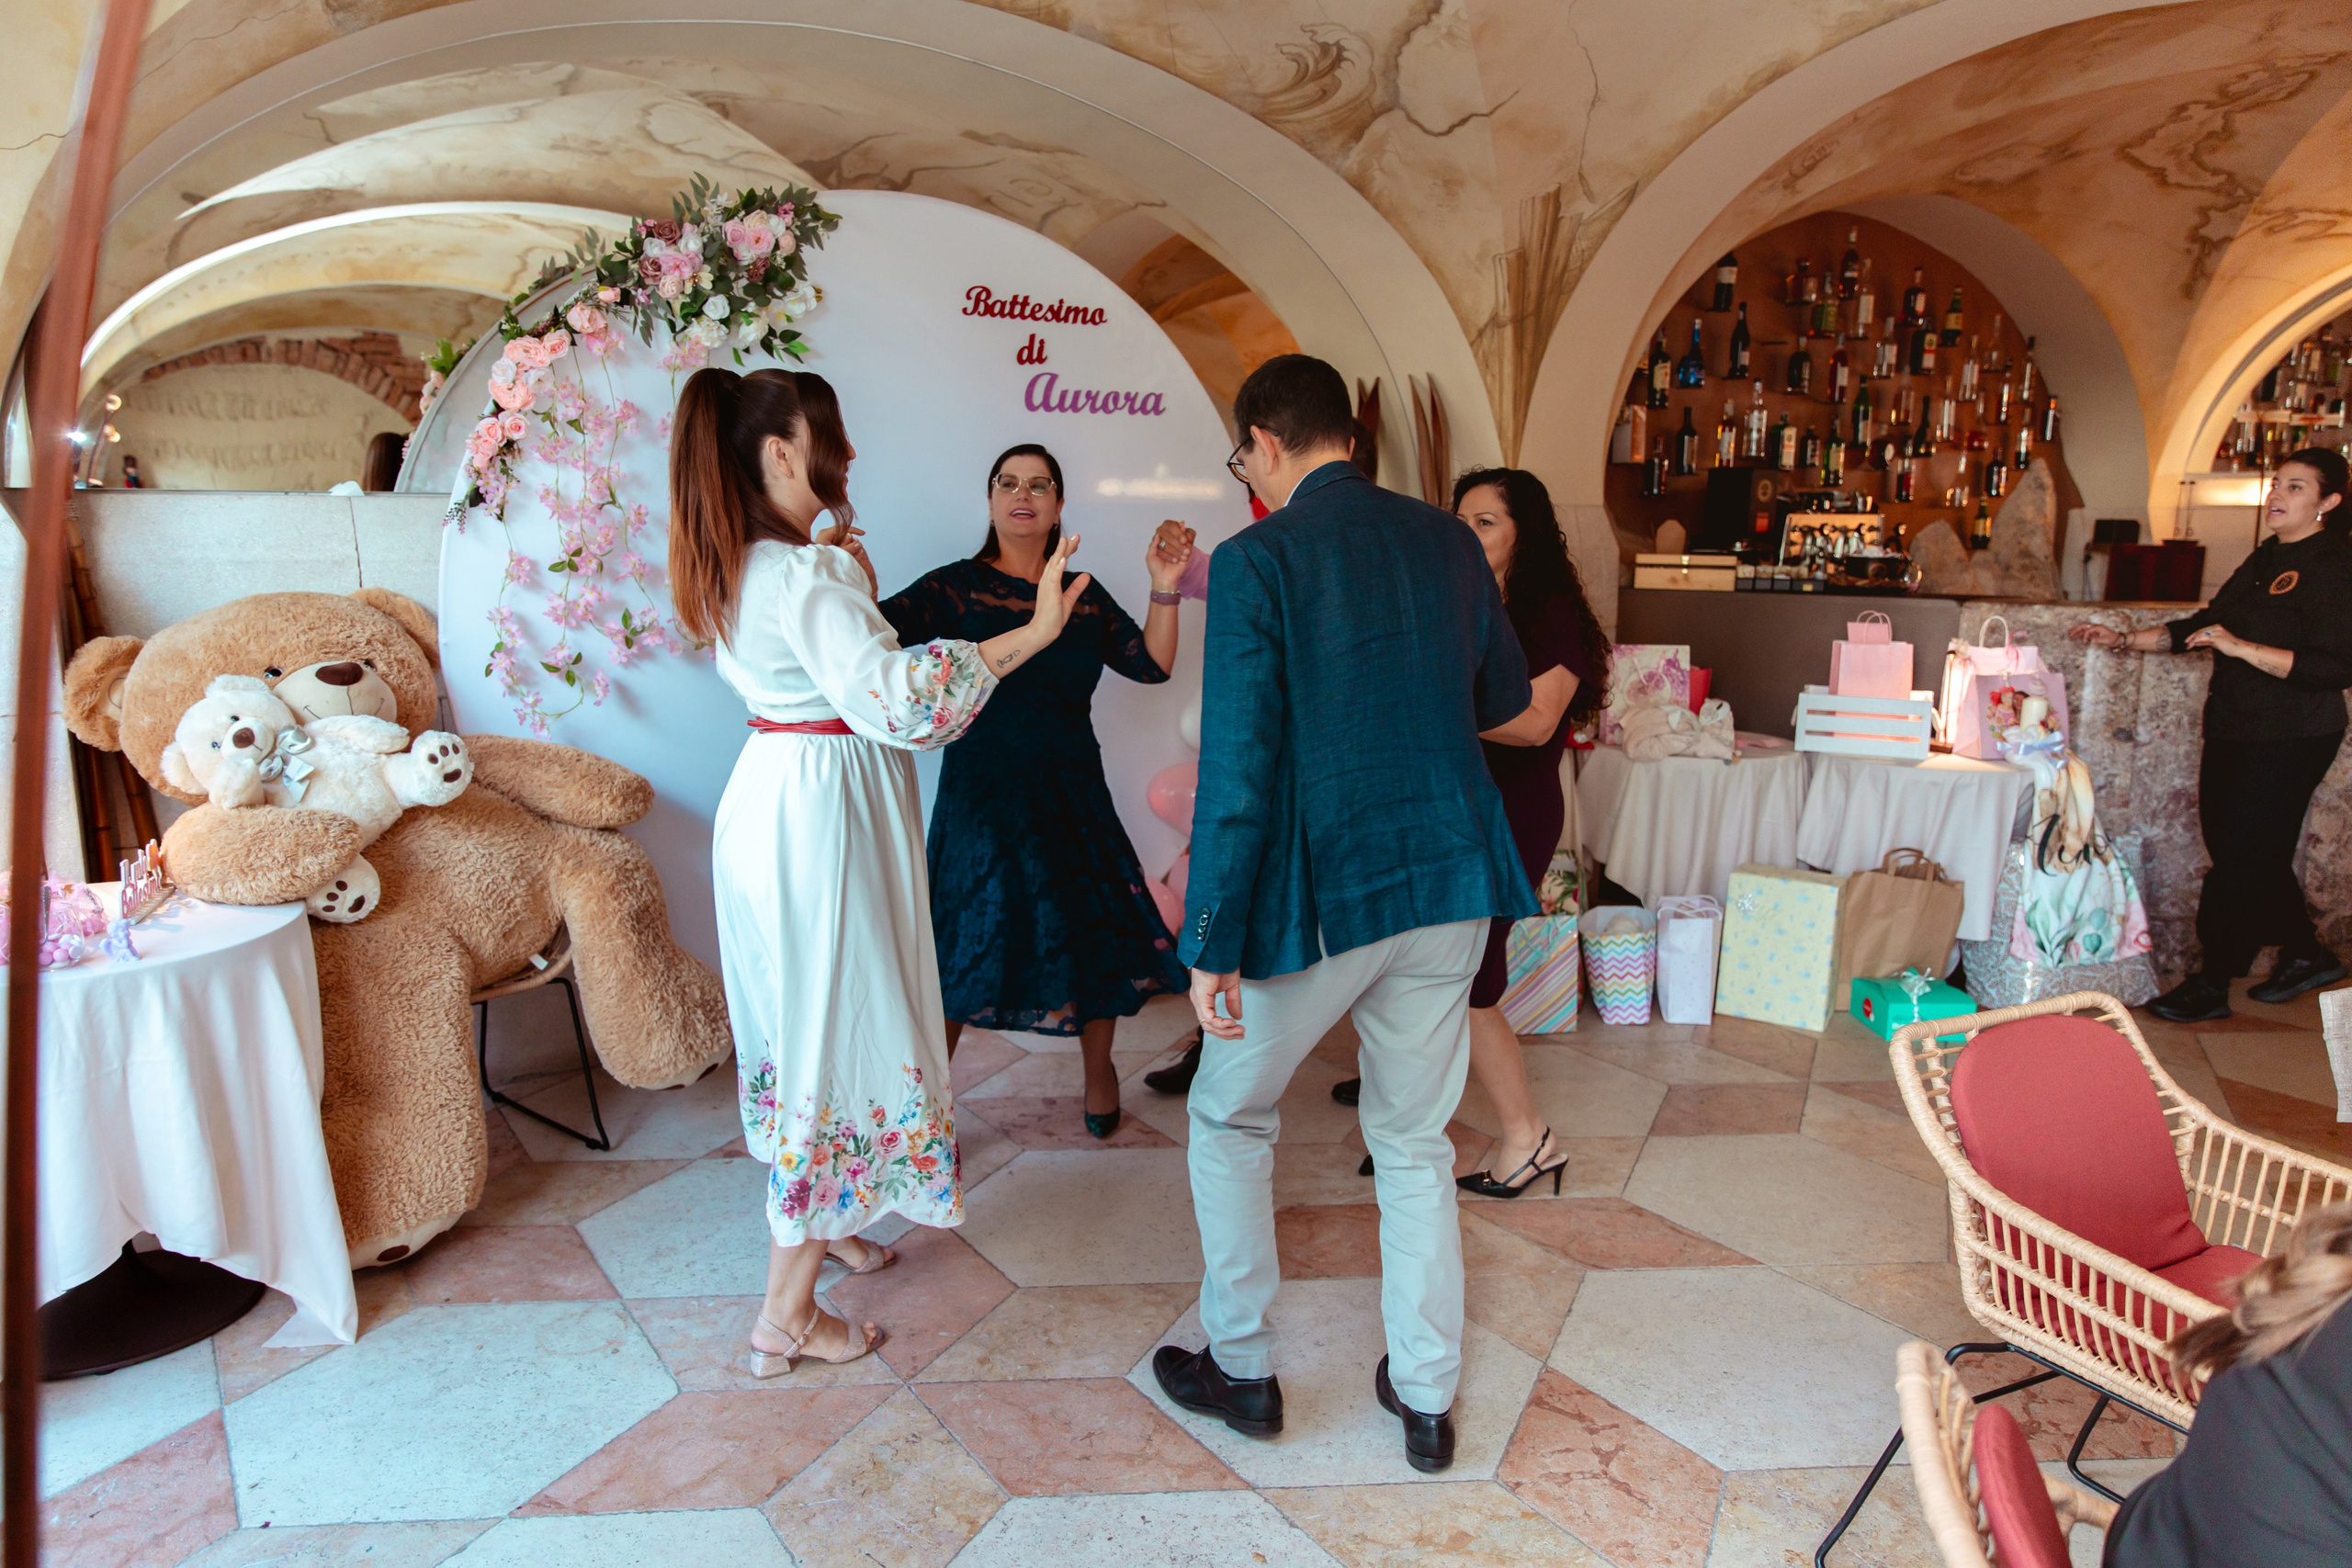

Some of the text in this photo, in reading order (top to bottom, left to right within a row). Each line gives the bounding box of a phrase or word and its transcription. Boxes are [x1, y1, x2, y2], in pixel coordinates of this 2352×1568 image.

[962, 285, 1107, 326] Battesimo
[1016, 333, 1047, 366] di
[1023, 372, 1166, 416] Aurora
